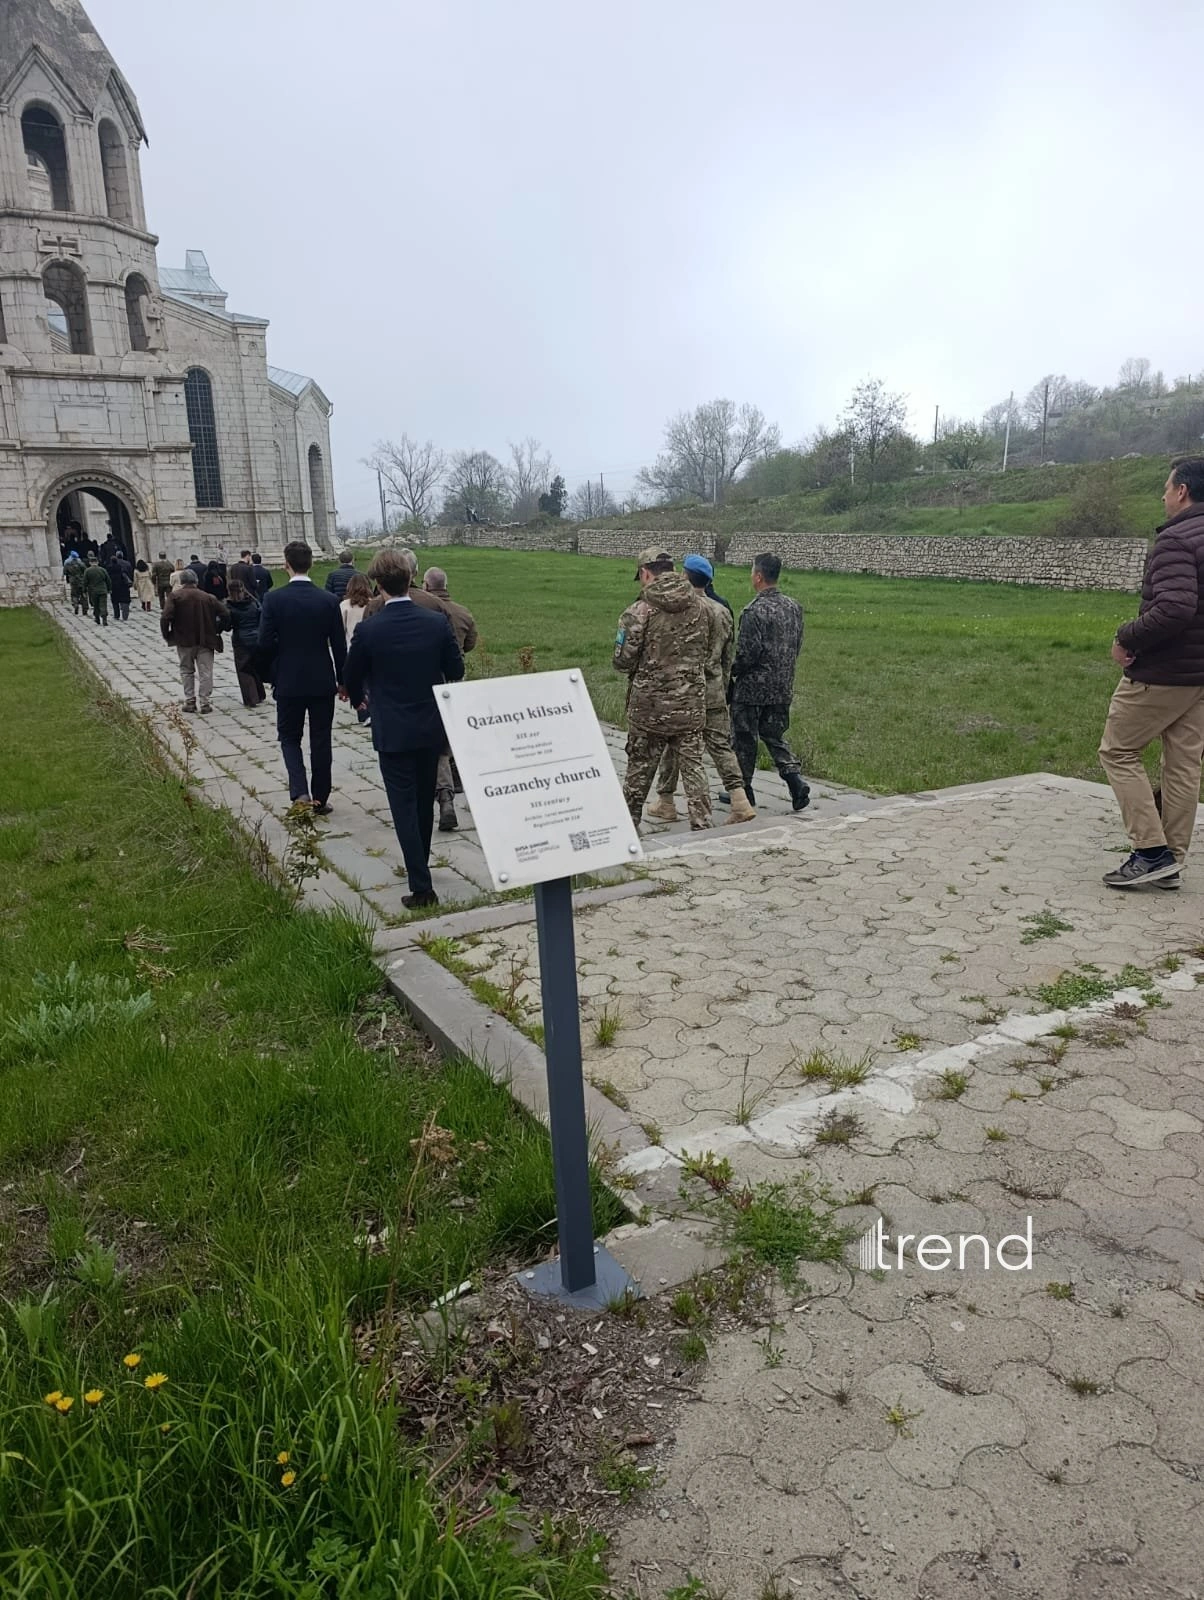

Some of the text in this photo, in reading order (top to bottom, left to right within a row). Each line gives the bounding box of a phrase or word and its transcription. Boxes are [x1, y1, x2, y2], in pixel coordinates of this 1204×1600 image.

[467, 702, 574, 730] Qazançı kilsəsi
[484, 766, 601, 798] Gazanchy church
